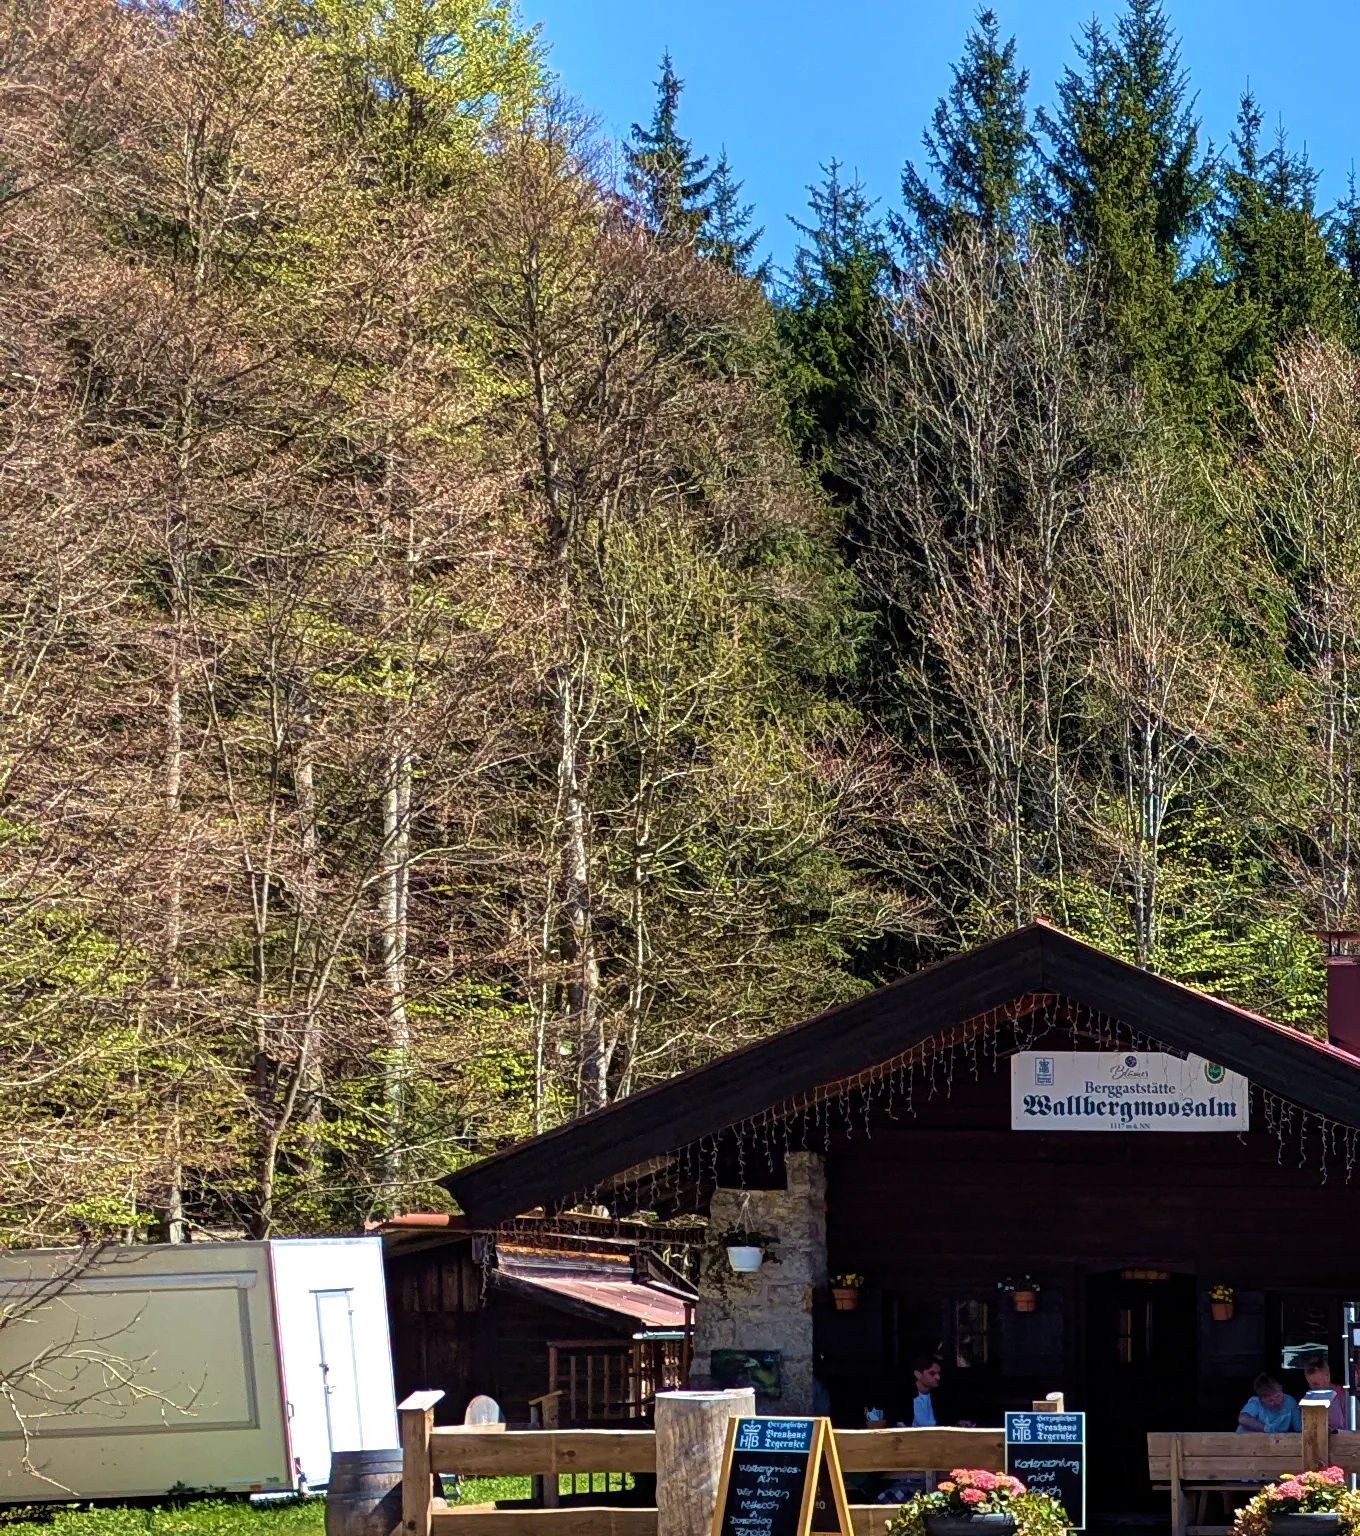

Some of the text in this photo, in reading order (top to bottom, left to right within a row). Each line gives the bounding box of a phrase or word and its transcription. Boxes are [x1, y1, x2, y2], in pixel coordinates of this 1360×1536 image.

[1085, 1080, 1176, 1098] Berggaststätte
[1023, 1094, 1237, 1122] Wallbergmoosalm
[740, 1432, 760, 1449] HTB
[1012, 1426, 1031, 1442] HTB
[1036, 1432, 1077, 1441] Tegernsee
[764, 1438, 805, 1450] Tegernsee
[1027, 1471, 1055, 1482] nicht
[736, 1487, 790, 1500] Wir haben
